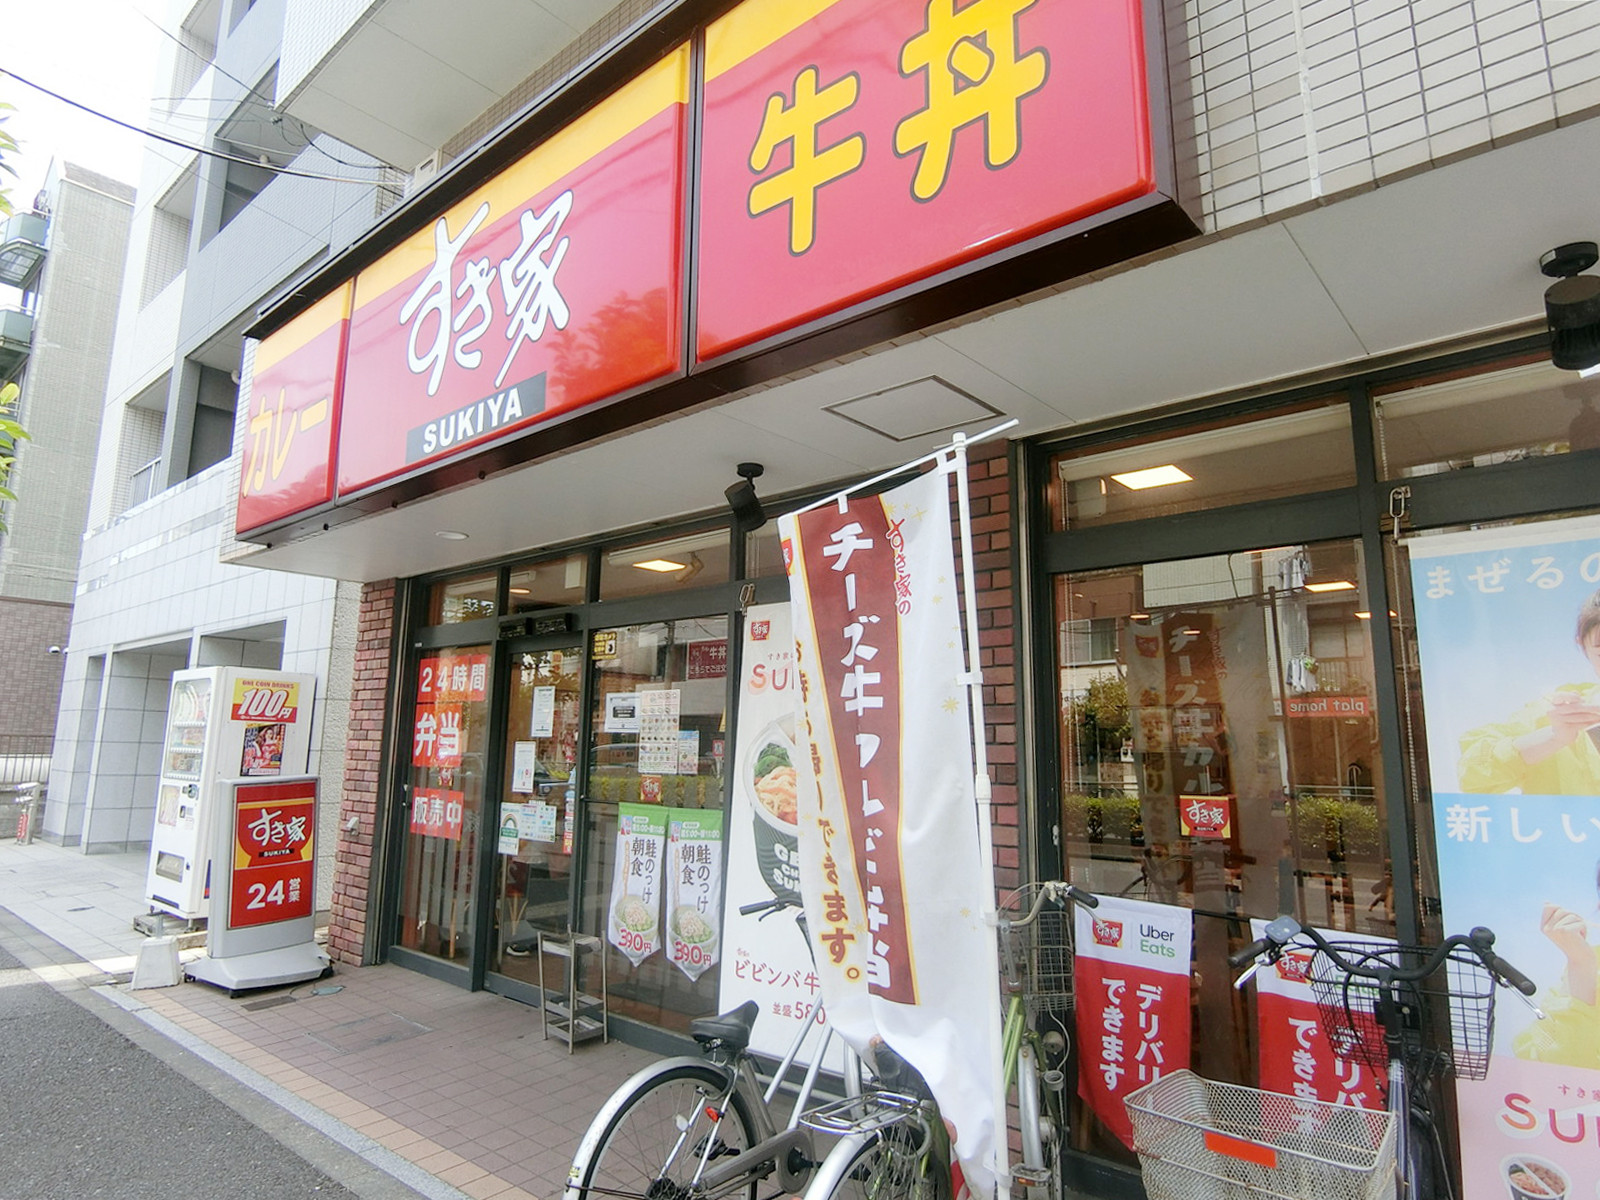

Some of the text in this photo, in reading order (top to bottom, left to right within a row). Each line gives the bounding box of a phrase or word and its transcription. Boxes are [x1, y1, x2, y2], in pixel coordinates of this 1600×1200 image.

[748, 0, 1050, 257] 牛丼
[400, 189, 574, 397] すき家
[422, 389, 522, 455] SUKIYA
[243, 388, 328, 498] カレー
[887, 518, 912, 616] すき家の
[1426, 552, 1600, 599] まぜるの
[420, 664, 487, 693] 24時間
[750, 663, 795, 691] SU
[237, 688, 293, 719] 100円
[414, 710, 460, 758] 弁当
[247, 808, 306, 848] すき家
[412, 797, 463, 829] 販売中
[1186, 800, 1224, 827] すき家
[1446, 804, 1600, 843] 新しい
[263, 849, 291, 857] SUKIYA
[631, 837, 645, 877] 朝食
[643, 838, 657, 904] 鮭のっけ
[681, 844, 695, 885] 朝食
[246, 880, 285, 910] 24
[696, 844, 712, 914] 鮭のっけ
[618, 928, 652, 954] 390円
[1140, 924, 1175, 942] Uber
[1140, 939, 1176, 958] Eats
[674, 941, 712, 967] 390円
[735, 959, 821, 996] ビビンバ牛
[1100, 977, 1127, 1091] できます
[1501, 1092, 1600, 1148] SU
